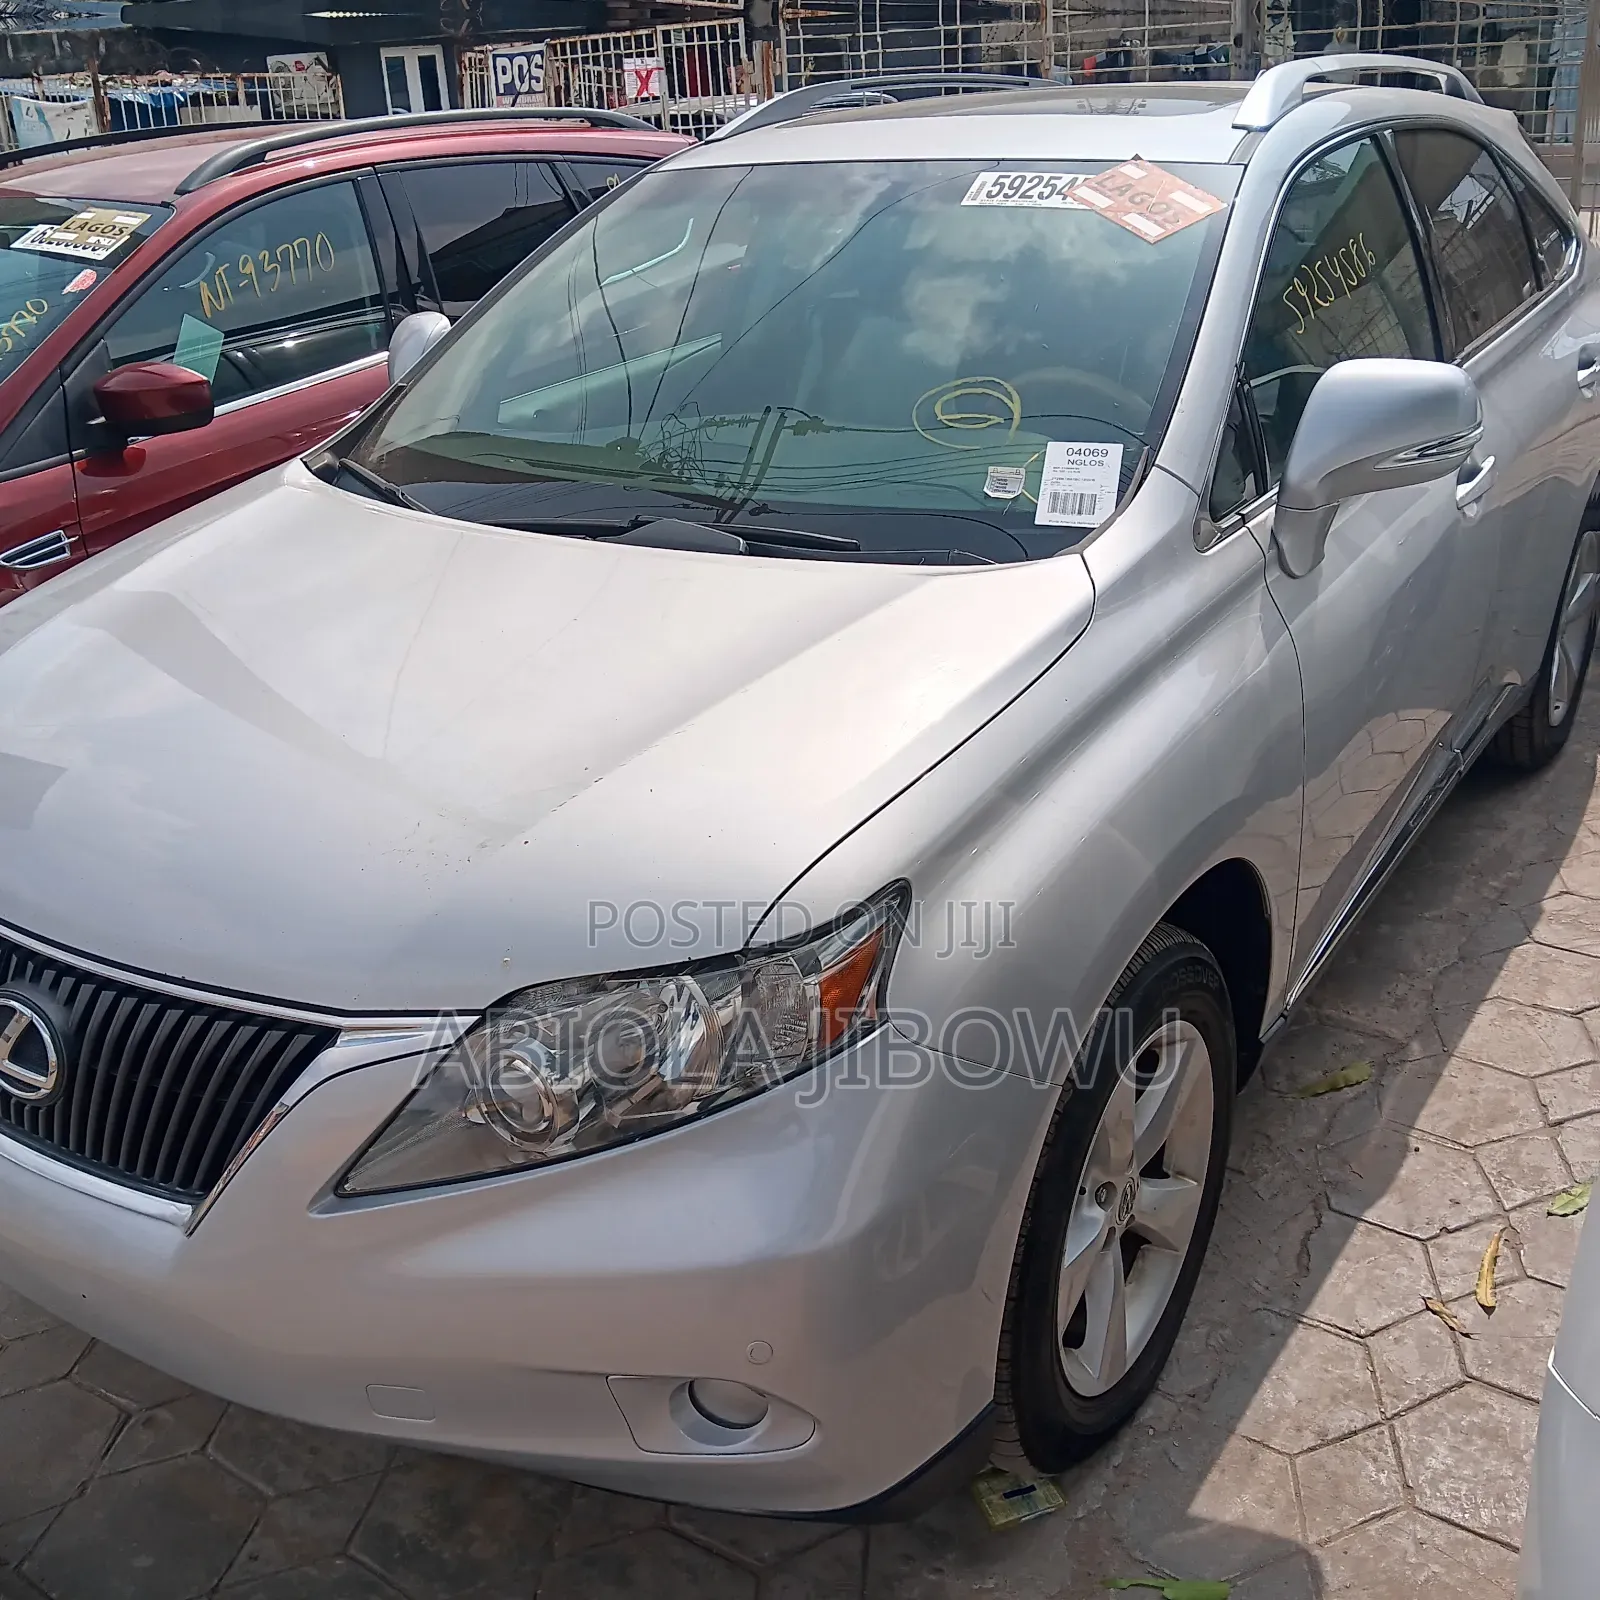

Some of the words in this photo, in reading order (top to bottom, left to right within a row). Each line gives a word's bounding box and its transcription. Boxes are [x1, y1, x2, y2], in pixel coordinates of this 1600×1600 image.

[497, 53, 543, 93] POS
[985, 174, 1092, 201] 59254
[1095, 174, 1180, 224] LAGOS
[64, 219, 129, 237] LAGOS
[200, 231, 335, 318] NT-93770
[1283, 232, 1376, 334] 59254586
[1066, 447, 1109, 458] 04069
[1067, 459, 1105, 467] NGLOS
